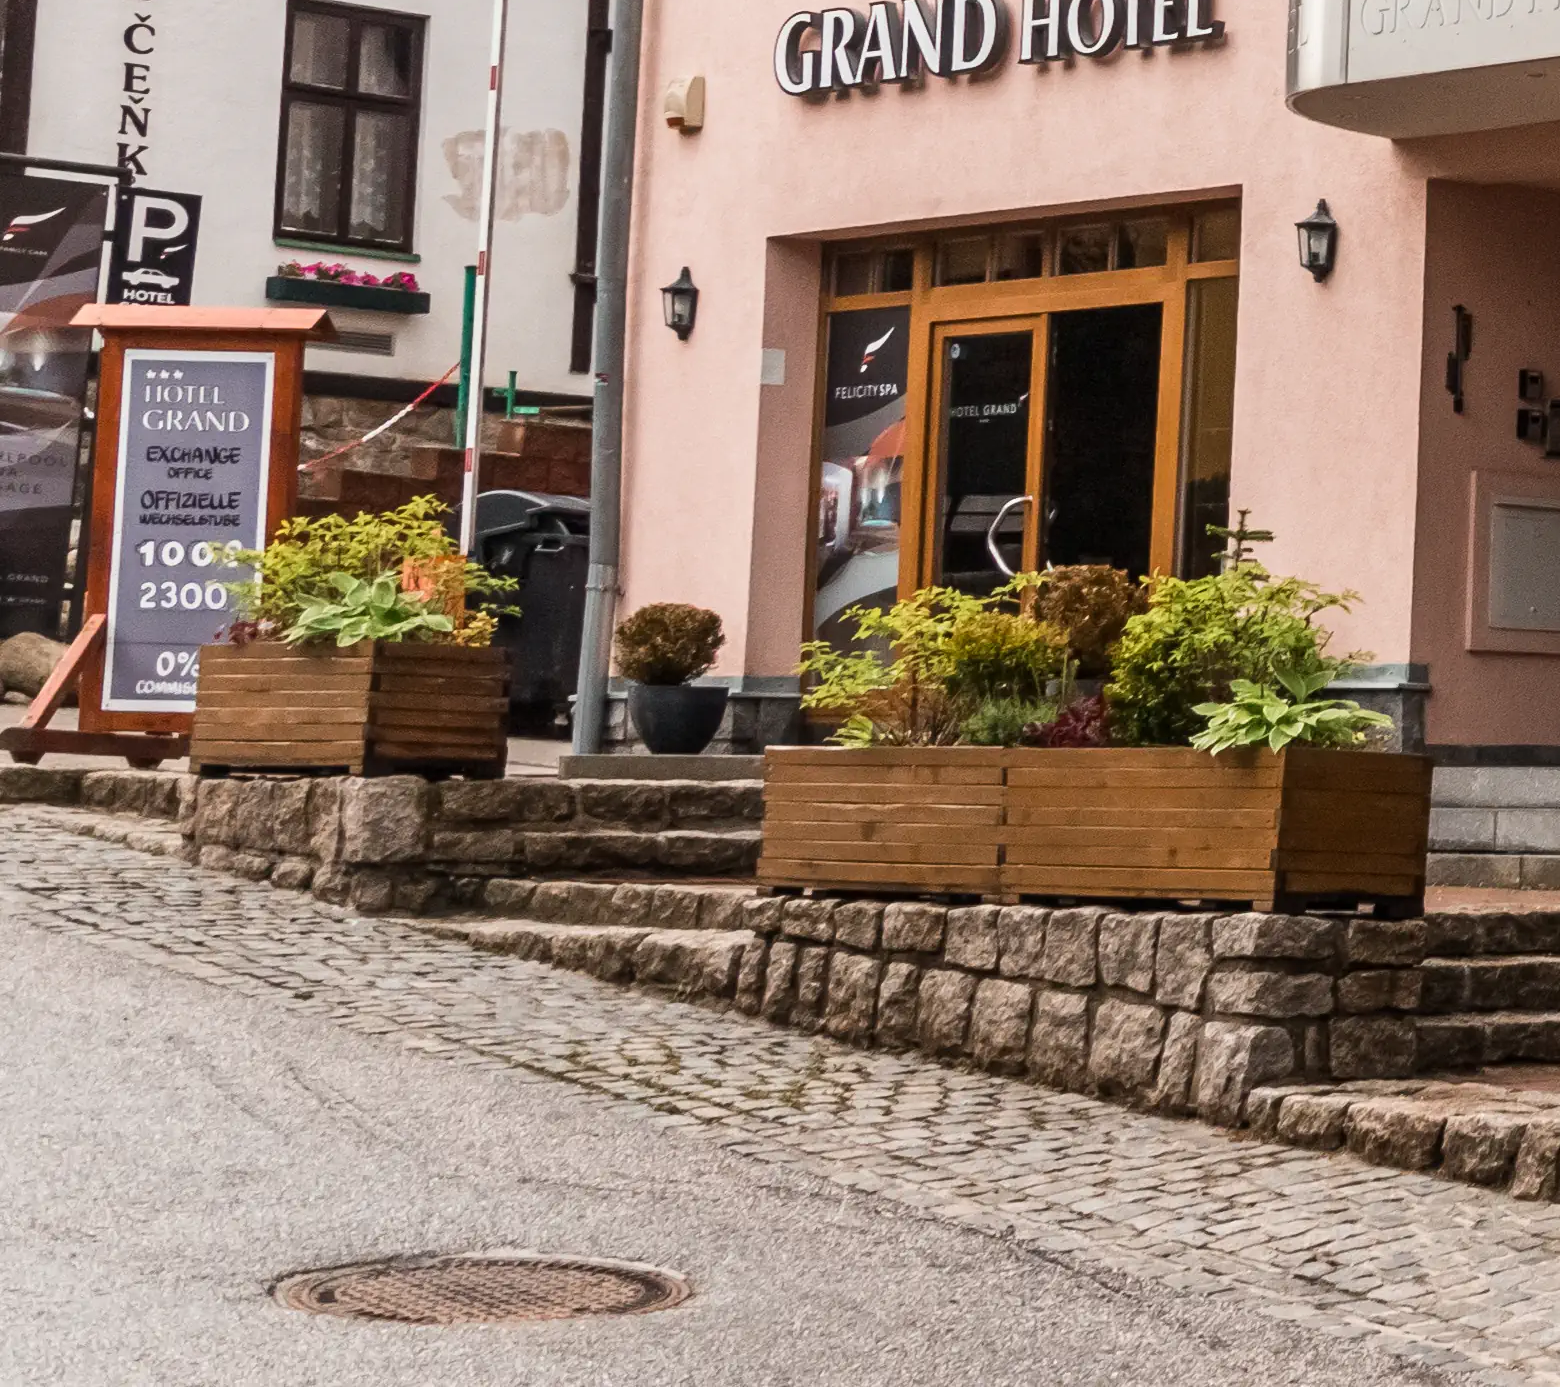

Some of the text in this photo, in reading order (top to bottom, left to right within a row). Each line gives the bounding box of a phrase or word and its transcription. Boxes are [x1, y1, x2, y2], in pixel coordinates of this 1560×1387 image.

[127, 194, 189, 263] P
[122, 288, 176, 305] HOTEL
[144, 384, 226, 405] HOTEL
[983, 402, 1018, 416] GRAND
[141, 408, 251, 433] GRAND
[146, 445, 242, 465] EXCHANGE
[167, 465, 213, 481] OFFICE
[140, 489, 242, 511] OFFIZIELLE
[139, 513, 242, 527] WECHSELSTUBE
[139, 580, 228, 610] 2300
